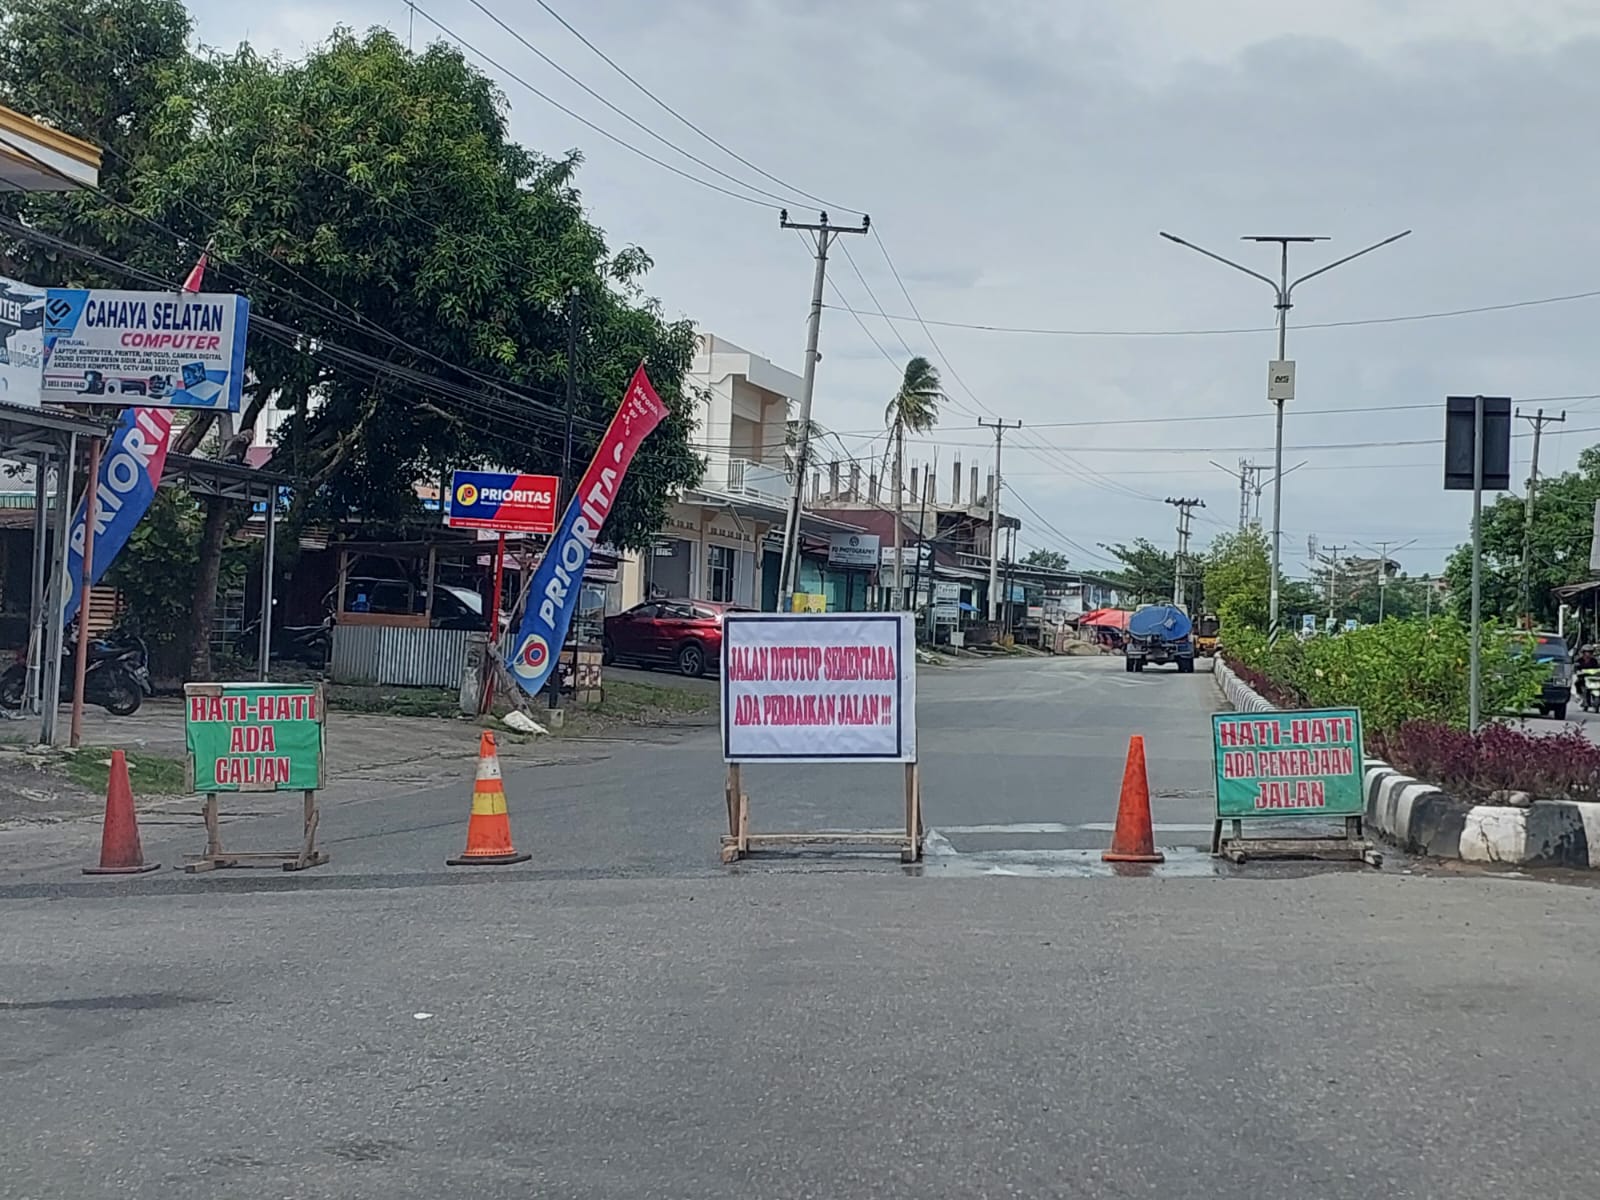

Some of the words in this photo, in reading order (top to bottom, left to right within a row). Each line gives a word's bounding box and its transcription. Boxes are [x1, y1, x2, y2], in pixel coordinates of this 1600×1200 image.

[0, 298, 21, 322] TER
[86, 300, 147, 330] CAHAYA
[152, 301, 224, 332] SELATAN
[121, 333, 220, 350] COMPUTER
[480, 487, 552, 504] PRIORITAS
[729, 646, 769, 681] JALAN
[771, 646, 822, 681] DITUTUP
[824, 646, 896, 681] SEMENTARA
[190, 695, 316, 721] HATI-HATI
[734, 694, 762, 726] ADA
[763, 694, 836, 726] PERBAIKAN
[838, 694, 879, 725] JALAN
[230, 727, 275, 752] ADA
[1220, 718, 1353, 746] HATI-HATI
[215, 757, 290, 784] GALIAN
[1224, 753, 1255, 778] ADA
[1258, 748, 1353, 777] PEKERJAAN
[1255, 782, 1325, 809] JALAN
